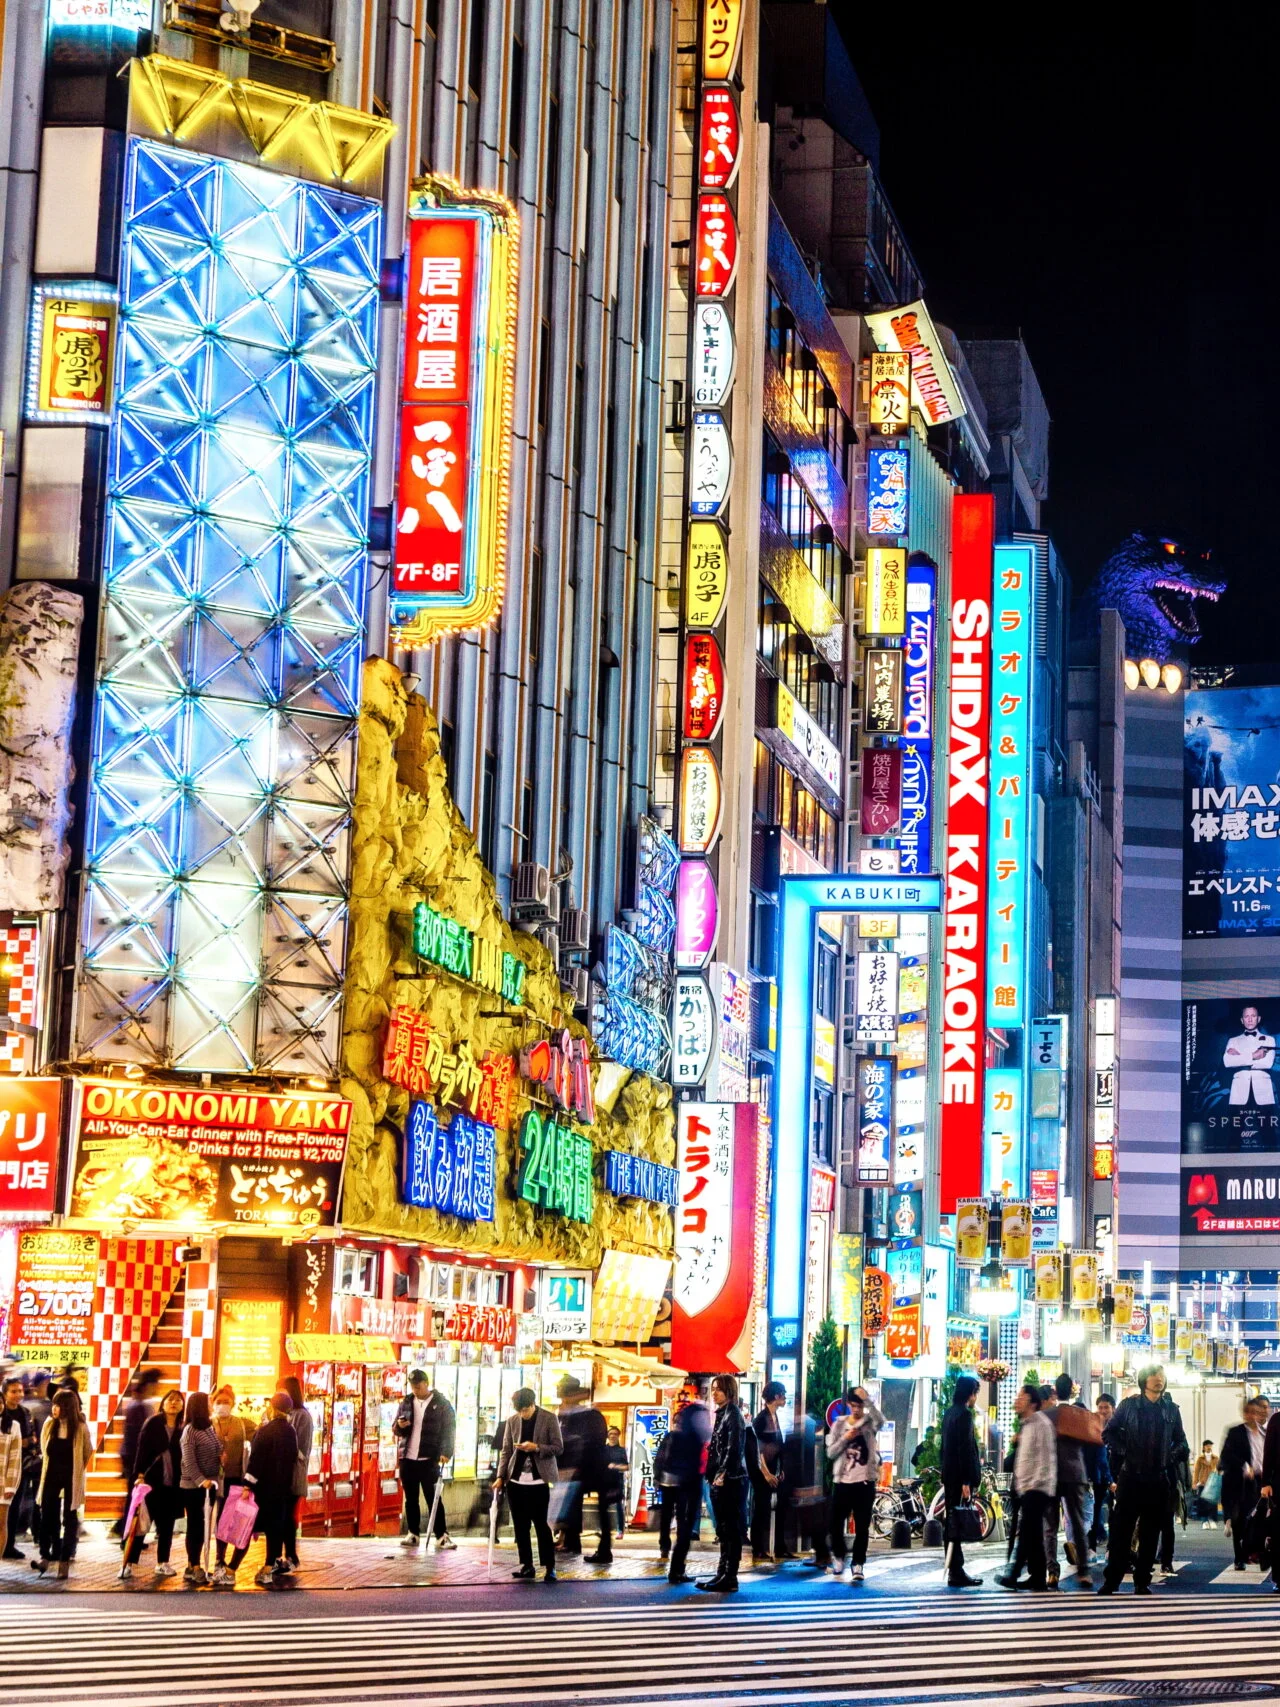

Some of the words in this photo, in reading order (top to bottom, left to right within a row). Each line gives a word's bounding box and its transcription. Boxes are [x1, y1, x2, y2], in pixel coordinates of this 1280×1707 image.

[700, 282, 722, 293] 7F
[49, 300, 78, 313] 4F
[414, 257, 462, 390] 居酒屋
[62, 336, 95, 387] 虎の子
[697, 388, 721, 401] 6F
[881, 423, 897, 434] 8F
[397, 420, 463, 535] つぼ八
[697, 503, 713, 512] 5F
[694, 552, 721, 602] 虎の子
[691, 612, 708, 621] 4F
[870, 653, 893, 721] 山内農場
[950, 599, 990, 808] SHIDAX
[876, 721, 890, 731] 5F
[872, 753, 892, 827] 焼肉屋さかい
[1188, 876, 1272, 896] エベレスト
[870, 920, 888, 933] 3F
[1219, 919, 1258, 929] IMAX
[943, 834, 979, 1105] KARAOKE
[680, 985, 702, 995] 新宿
[679, 997, 704, 1057] かっぱ
[679, 1063, 699, 1076] B1
[865, 1064, 885, 1120] 海の家
[87, 1088, 258, 1125] OKONOMI
[270, 1100, 350, 1130] YAKI
[85, 1120, 188, 1139] All-You-Can-Eat
[192, 1127, 232, 1141] dinner
[236, 1130, 262, 1142] with
[265, 1132, 344, 1148] Free-Flowing
[714, 1107, 731, 1177] 大衆酒場
[189, 1143, 229, 1157] Drinks
[232, 1146, 248, 1157] for
[253, 1147, 260, 1157] 2
[265, 1147, 300, 1159] hours
[303, 1149, 342, 1162] ¥2,700
[523, 1111, 593, 1223] 24時間
[683, 1116, 712, 1234] トラノコ
[302, 1212, 317, 1222] 2F
[1032, 1206, 1056, 1217] Cafe
[305, 1318, 319, 1331] 2F
[543, 1321, 588, 1336] 虎の子
